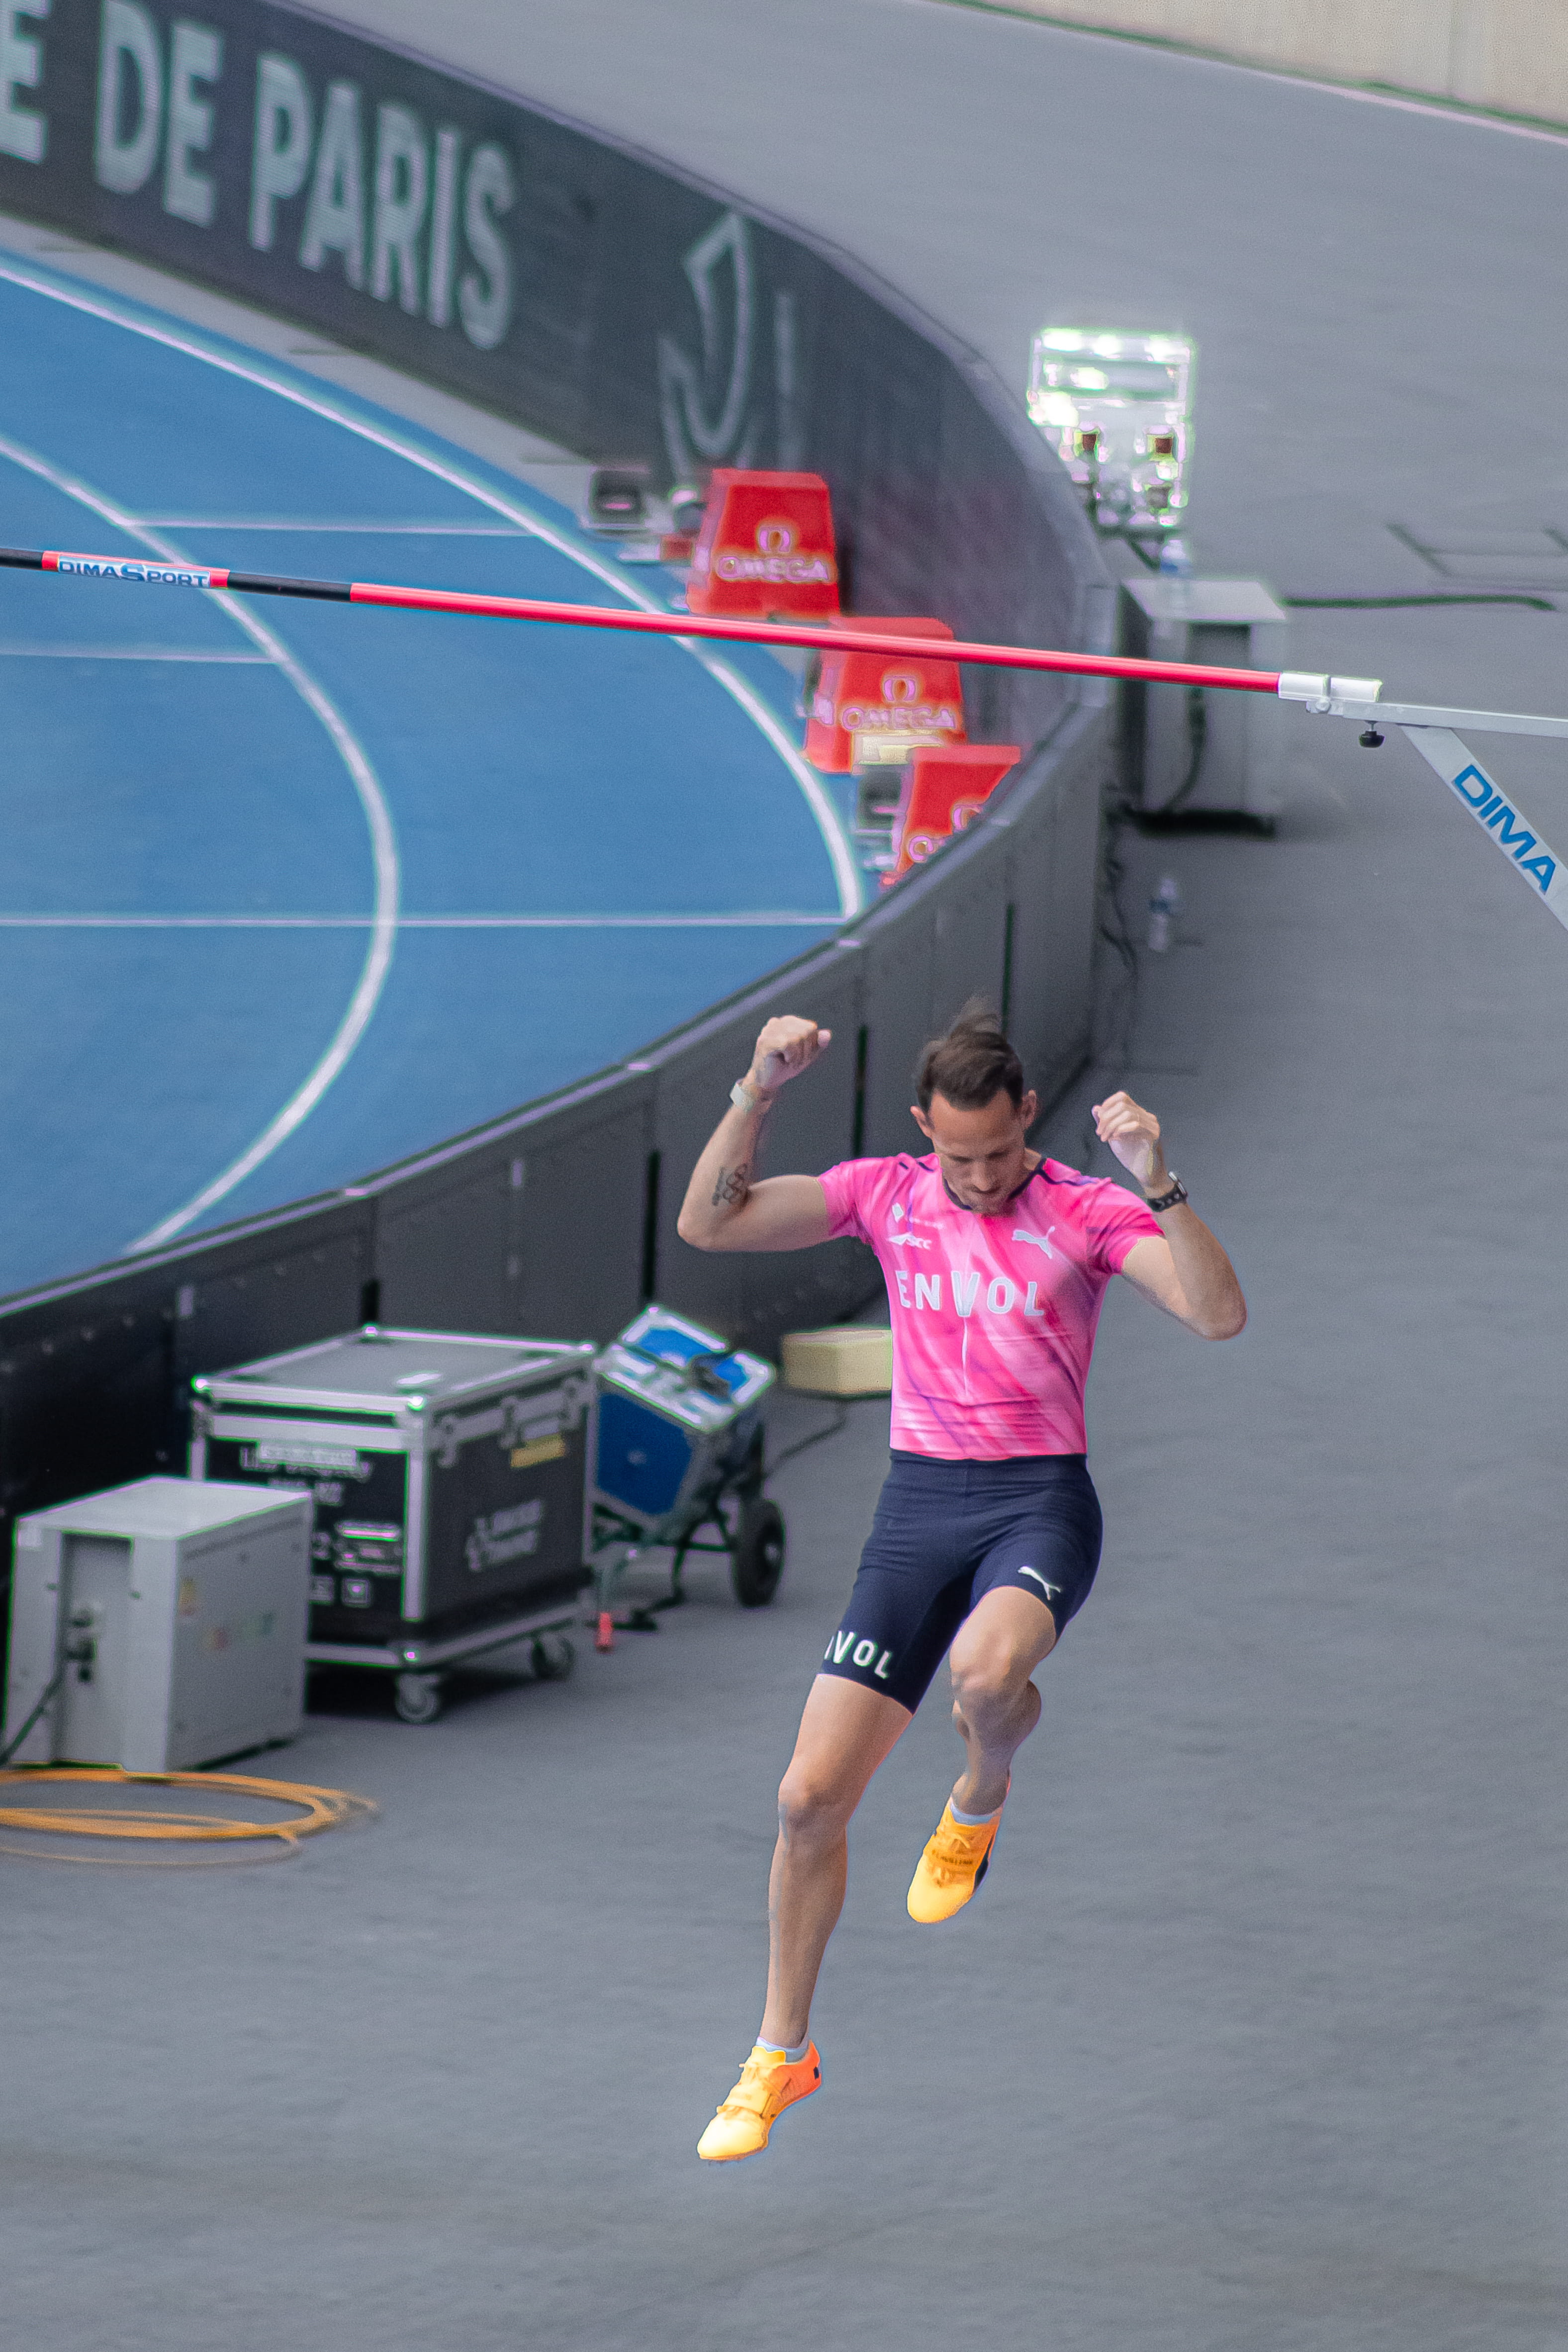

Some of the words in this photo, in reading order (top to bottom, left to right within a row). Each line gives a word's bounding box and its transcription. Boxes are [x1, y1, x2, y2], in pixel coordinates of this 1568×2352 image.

[94, 0, 222, 226] DE
[249, 52, 514, 350] PARIS
[717, 554, 830, 582] OMEGA
[842, 707, 956, 730] OMEGA
[1453, 764, 1556, 892] DIMA
